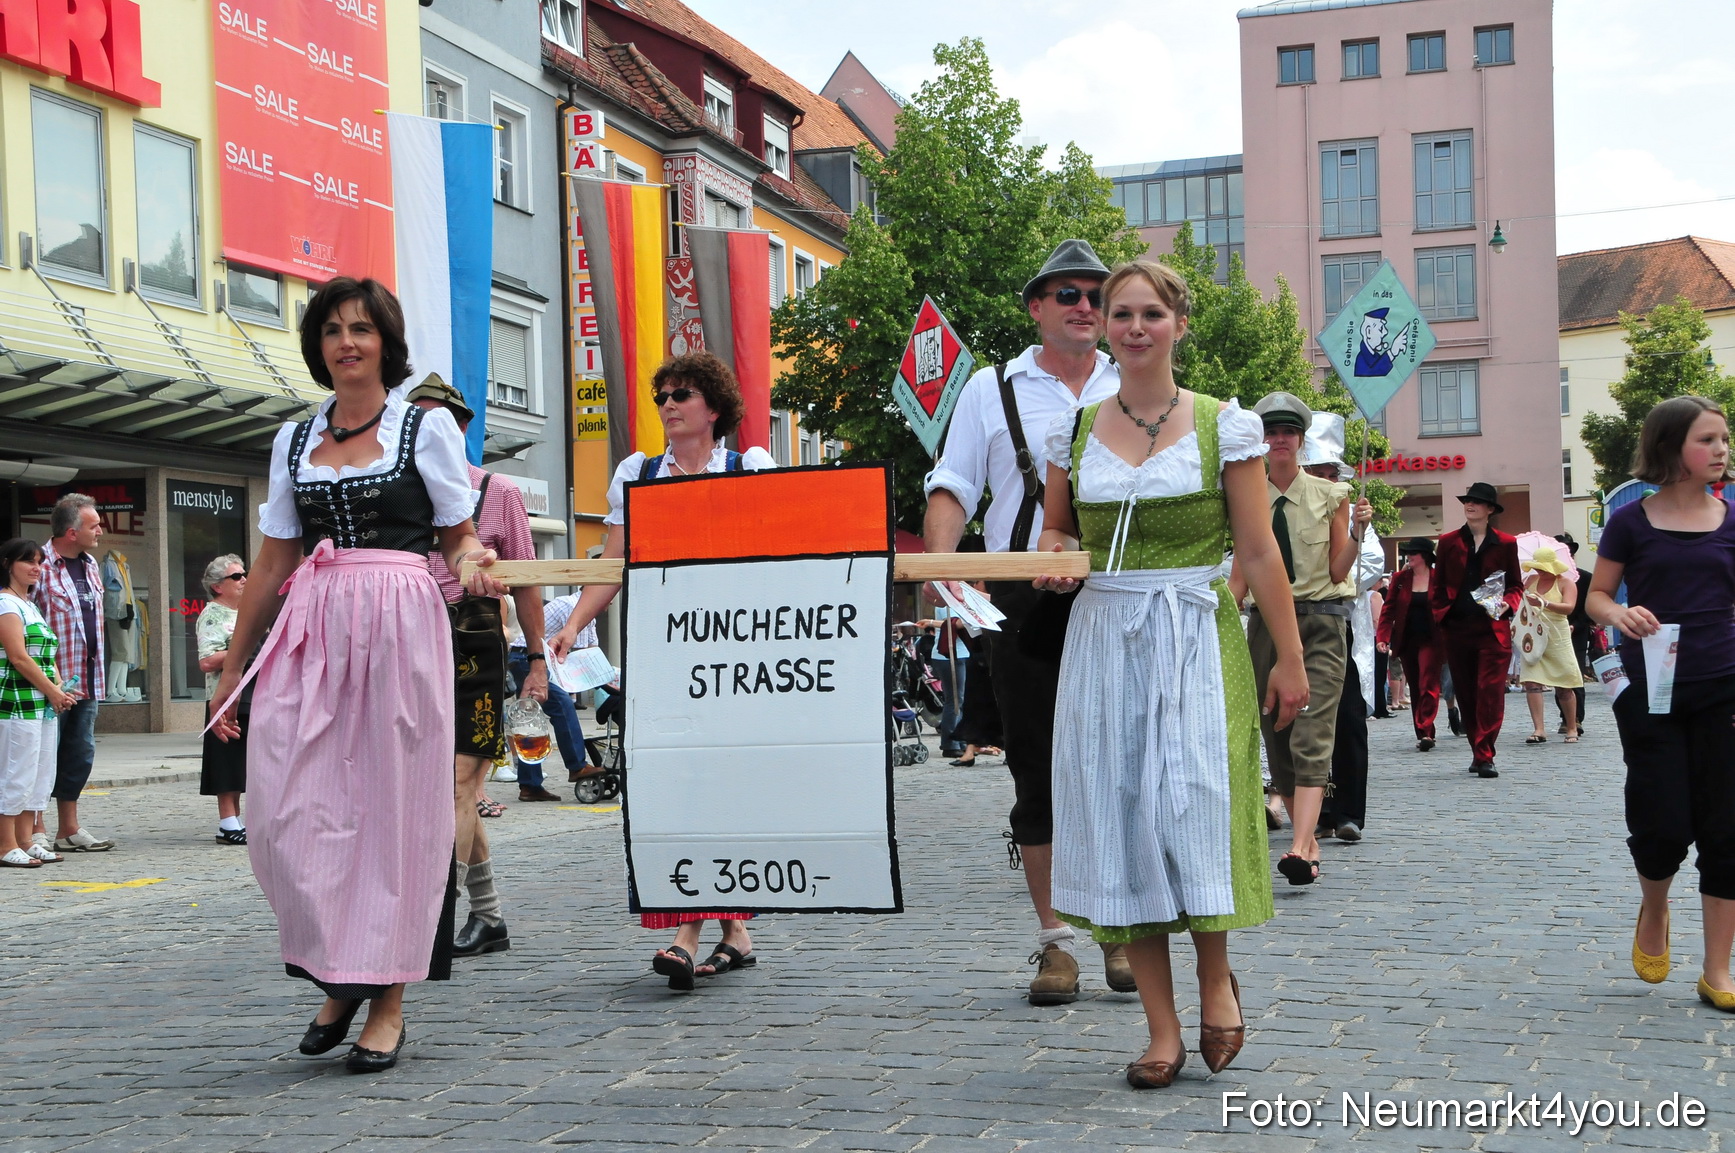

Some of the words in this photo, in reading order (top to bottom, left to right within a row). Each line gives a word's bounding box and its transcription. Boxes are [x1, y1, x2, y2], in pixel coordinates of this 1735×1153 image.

[218, 2, 269, 42] SALE
[335, 0, 378, 25] SALE
[307, 42, 354, 77] SALE
[254, 84, 299, 120] SALE
[340, 117, 383, 150] SALE
[225, 141, 274, 176] SALE
[313, 172, 359, 204] SALE
[1372, 290, 1379, 298] in
[1381, 290, 1393, 299] das
[1344, 337, 1354, 367] Gehen
[1409, 318, 1420, 363] Gefängnis
[577, 382, 606, 402] café
[937, 408, 946, 424] Nur
[943, 391, 952, 407] zum
[950, 361, 965, 390] Besuch
[577, 418, 607, 437] plank
[1356, 453, 1466, 478] parkasse
[173, 489, 234, 515] menstyle
[666, 602, 858, 643] MÜNCHENER
[688, 656, 836, 699] STRASSE
[669, 858, 700, 897] €
